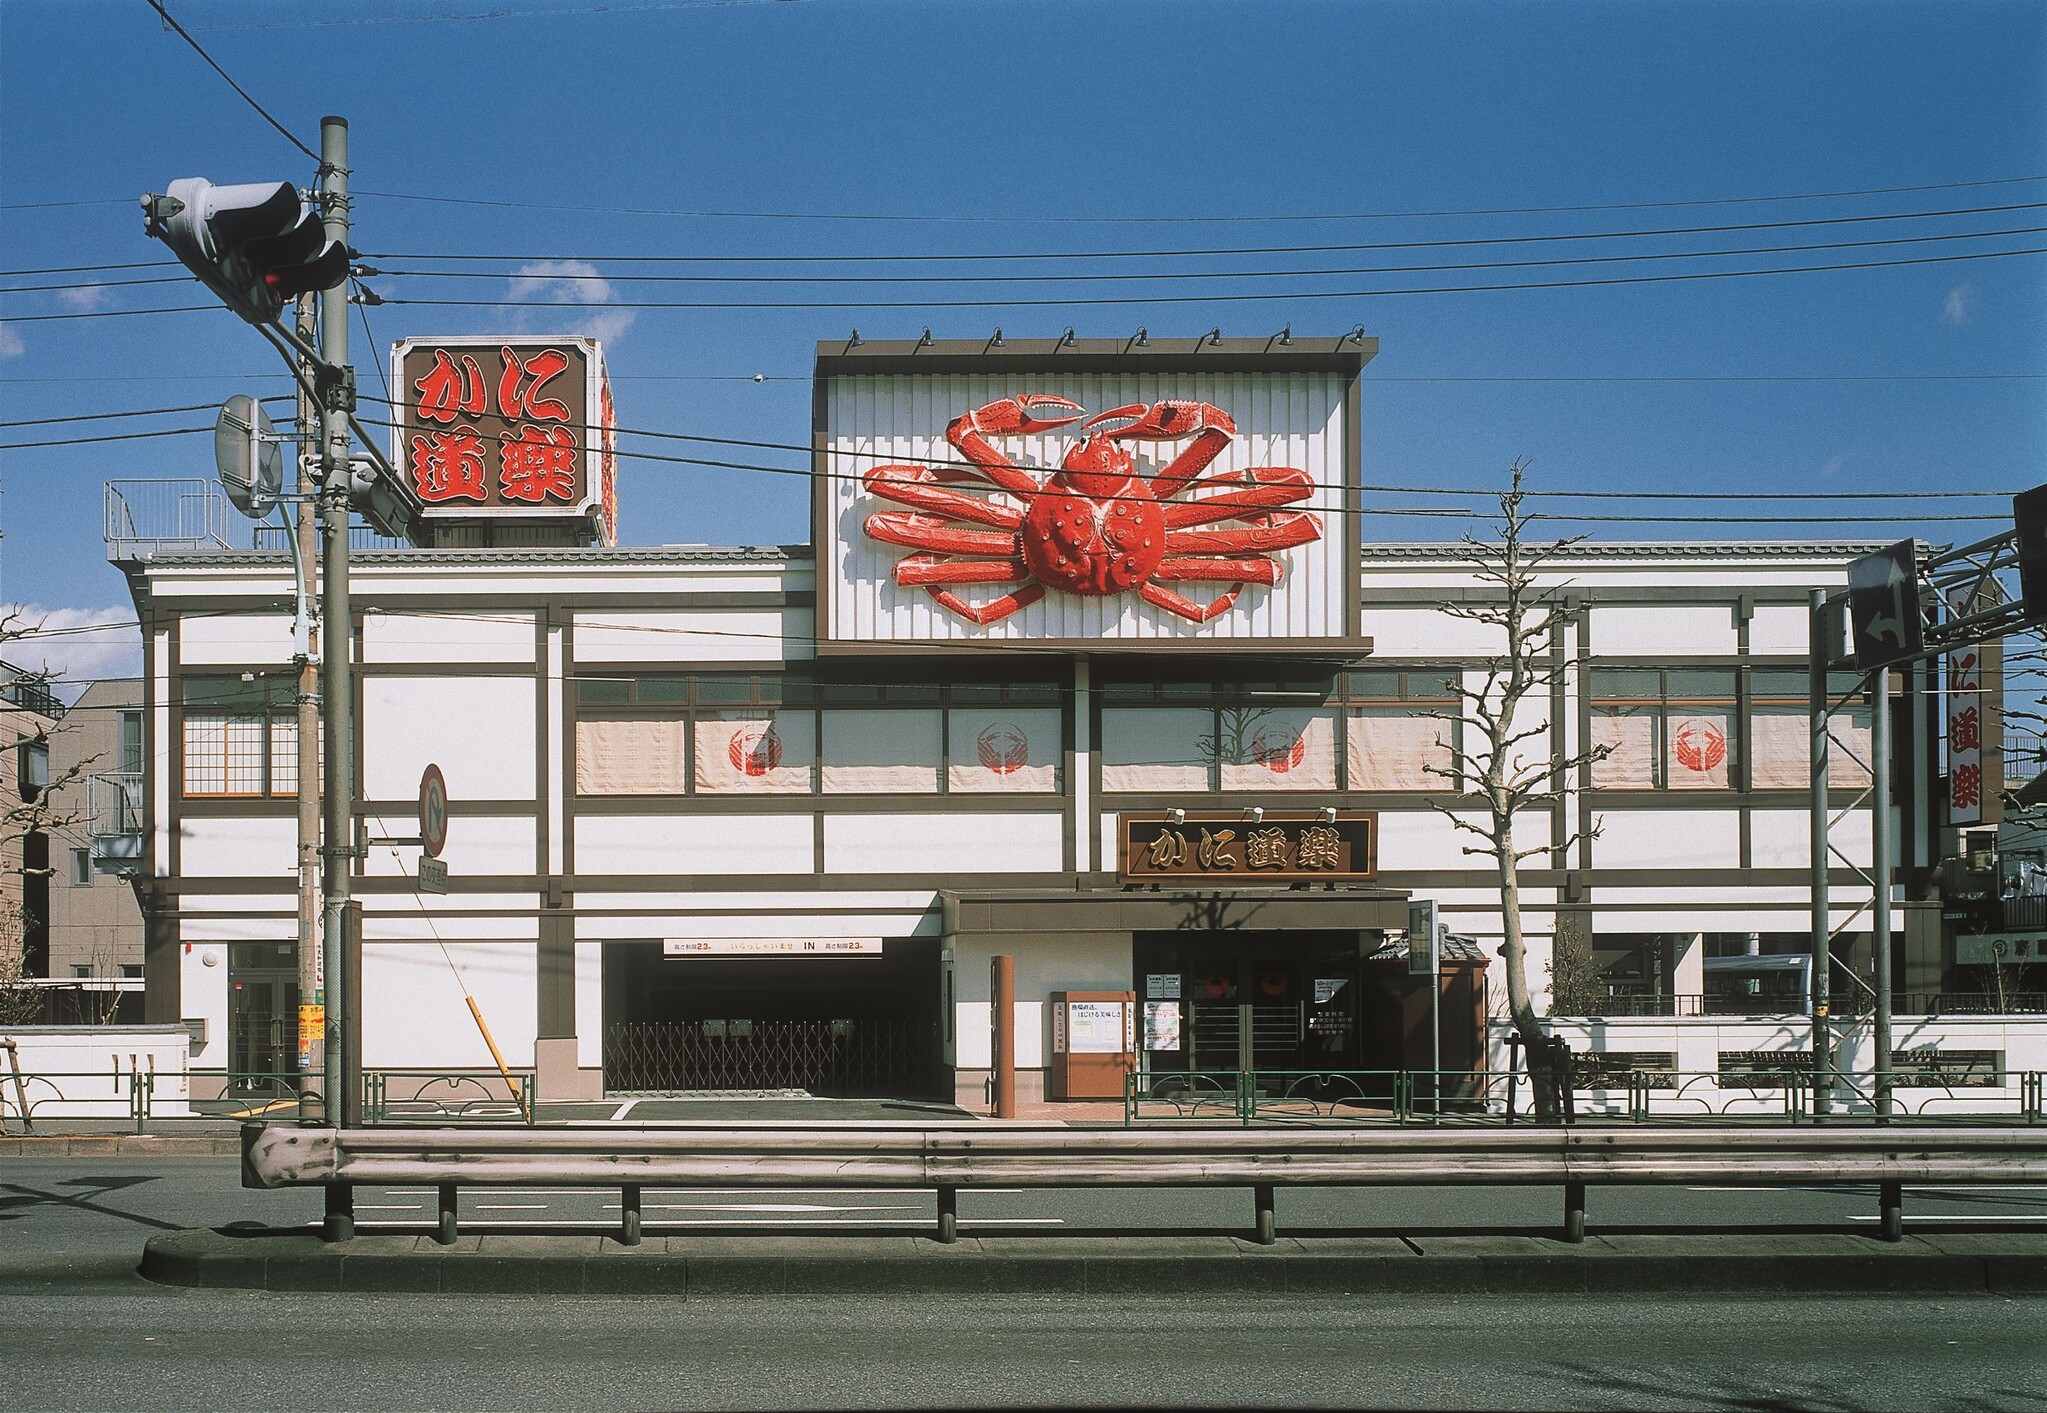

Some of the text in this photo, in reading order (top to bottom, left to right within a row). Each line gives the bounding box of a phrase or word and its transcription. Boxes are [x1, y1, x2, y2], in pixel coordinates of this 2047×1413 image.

[414, 345, 571, 422] かに
[730, 942, 793, 951] いらっしゃいませ
[803, 942, 815, 950] IN
